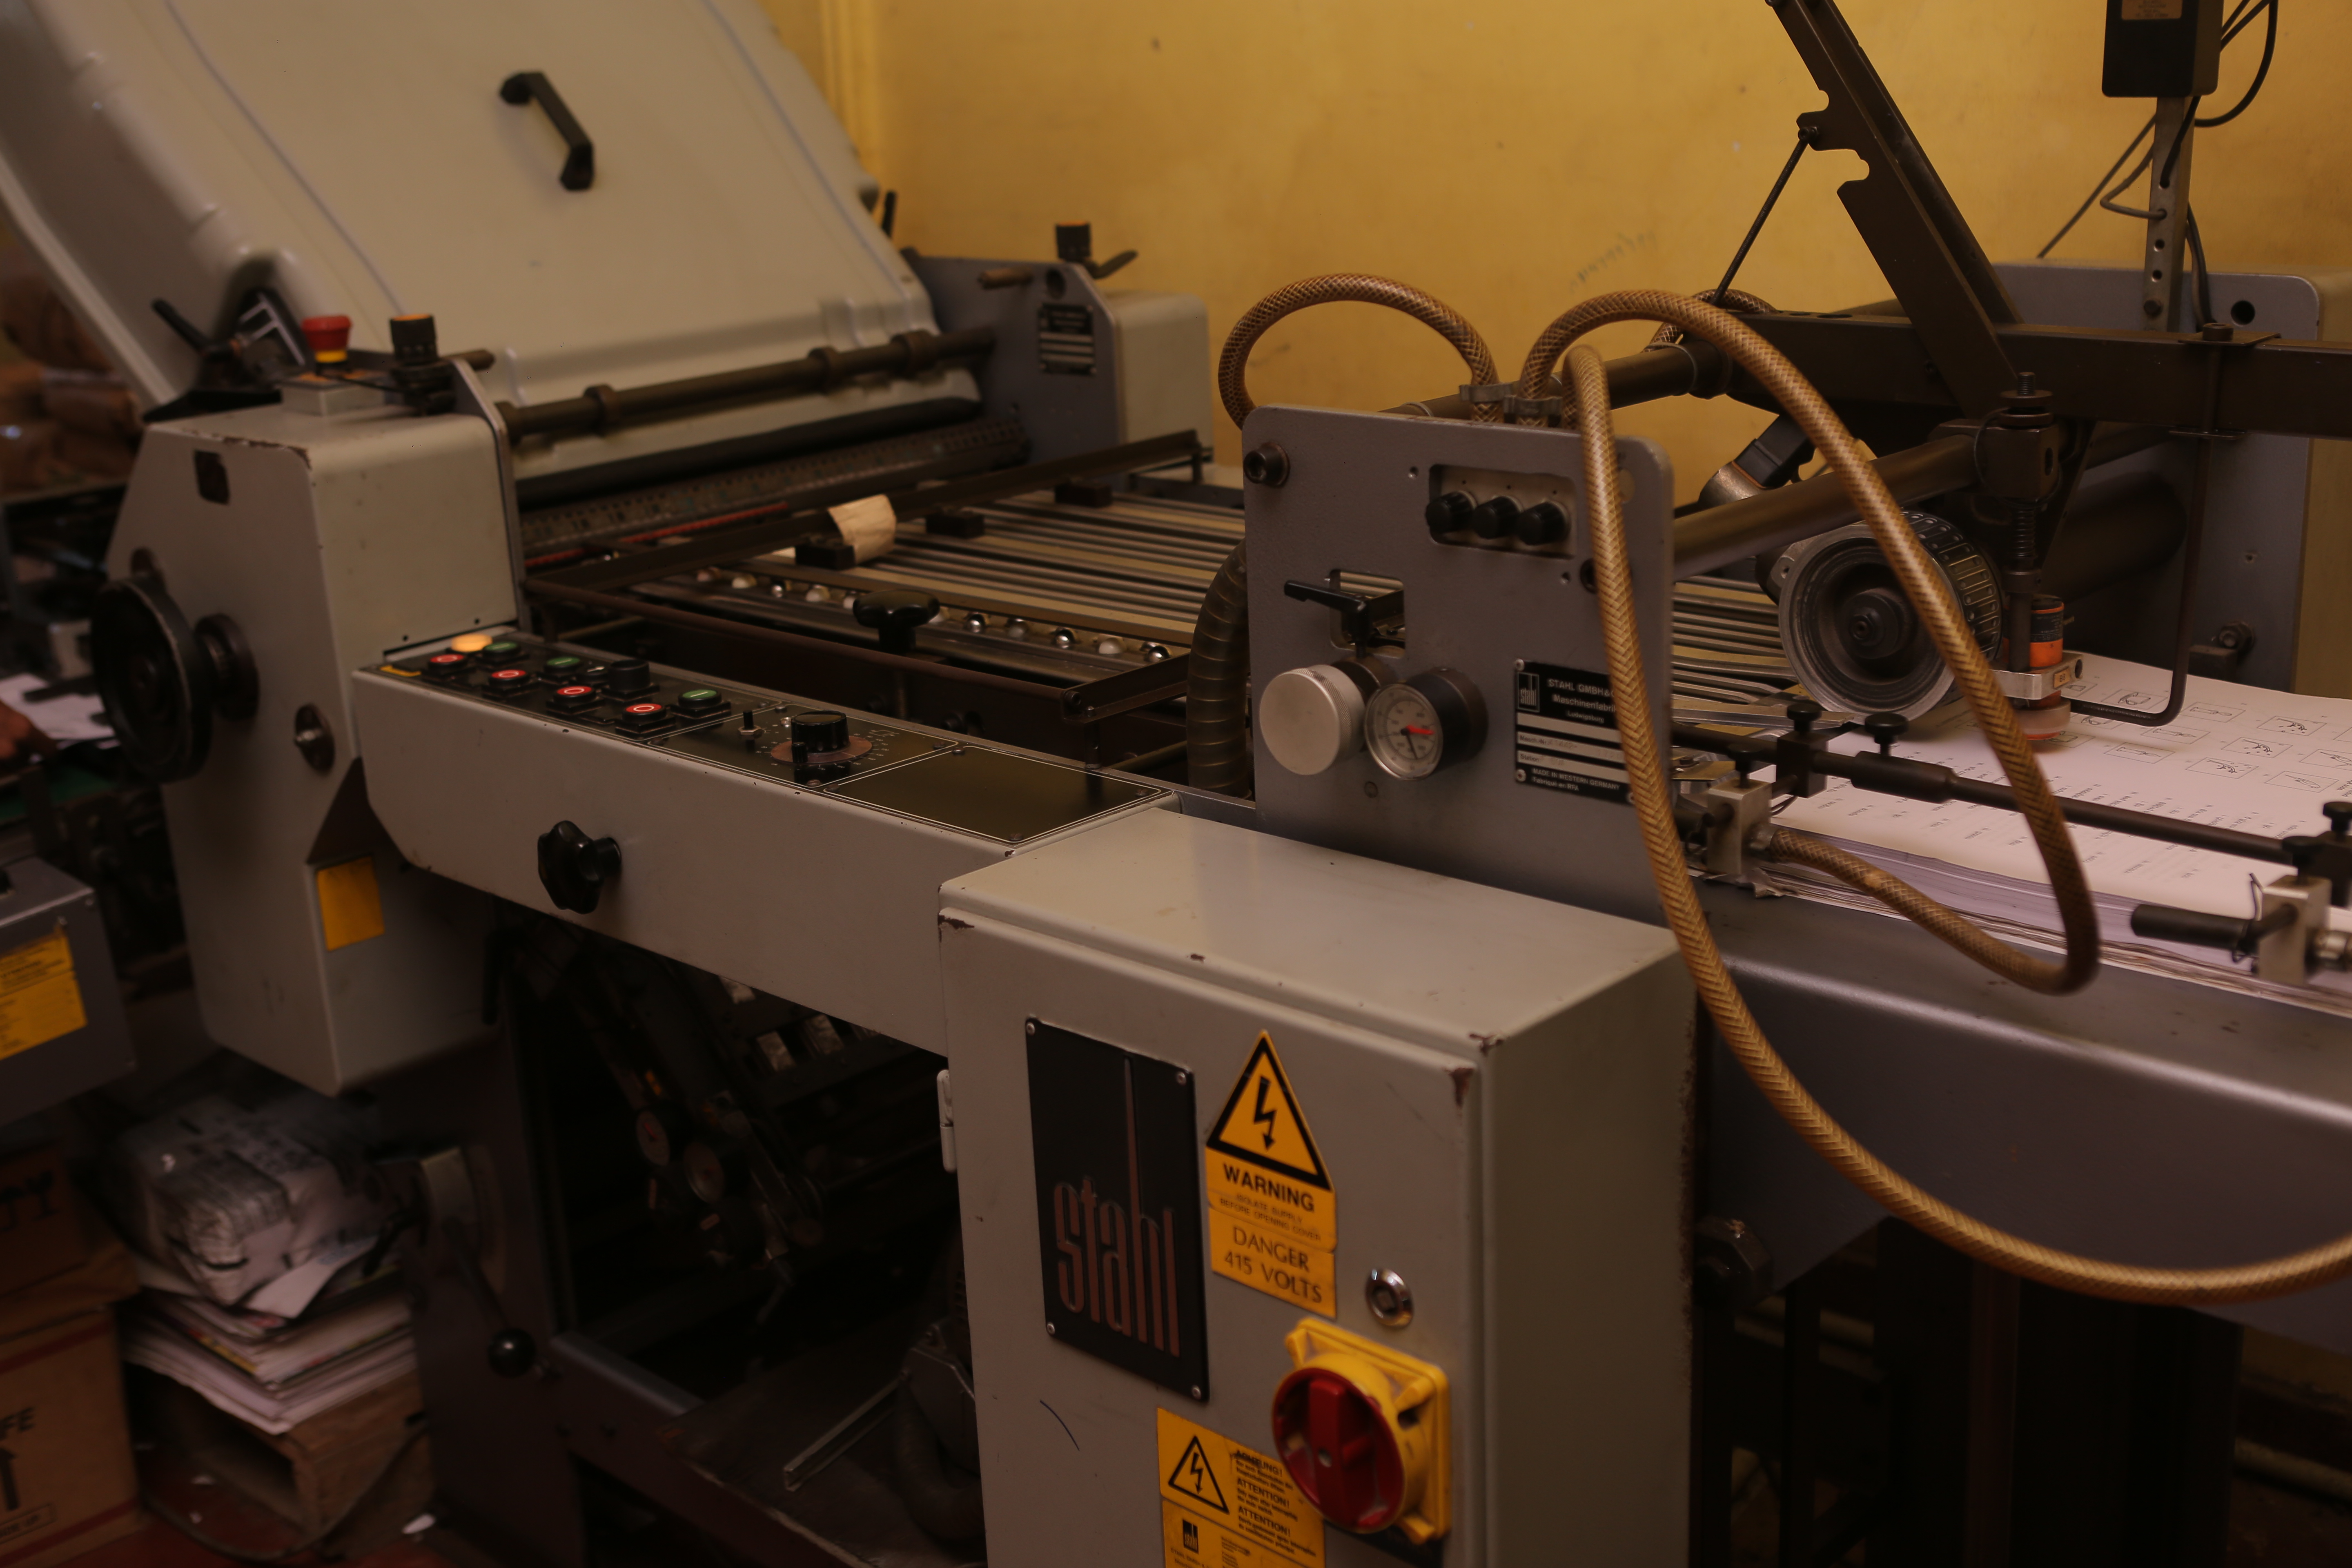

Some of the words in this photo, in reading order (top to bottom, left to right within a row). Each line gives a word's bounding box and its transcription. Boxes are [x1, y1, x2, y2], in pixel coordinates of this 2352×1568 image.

[1548, 679, 1575, 690] STAHL
[1578, 685, 1604, 695] GMBH
[1566, 710, 1605, 724] Ludwigsburg
[1533, 768, 1551, 776] MADE
[1559, 773, 1588, 784] WESTERN
[1590, 779, 1620, 791] GERMANY
[1224, 1164, 1315, 1213] WARNING
[1054, 1056, 1180, 1357] stahl
[1221, 1198, 1250, 1215] BEFORE
[1254, 1212, 1290, 1231] OPENING
[1272, 1207, 1303, 1224] SUPPLY
[1234, 1227, 1310, 1272] DANGER
[1225, 1252, 1252, 1275] 415
[1261, 1264, 1322, 1303] VOLTS
[1238, 1478, 1290, 1509] ATTENTION!
[1238, 1506, 1290, 1537] ATTENTION!
